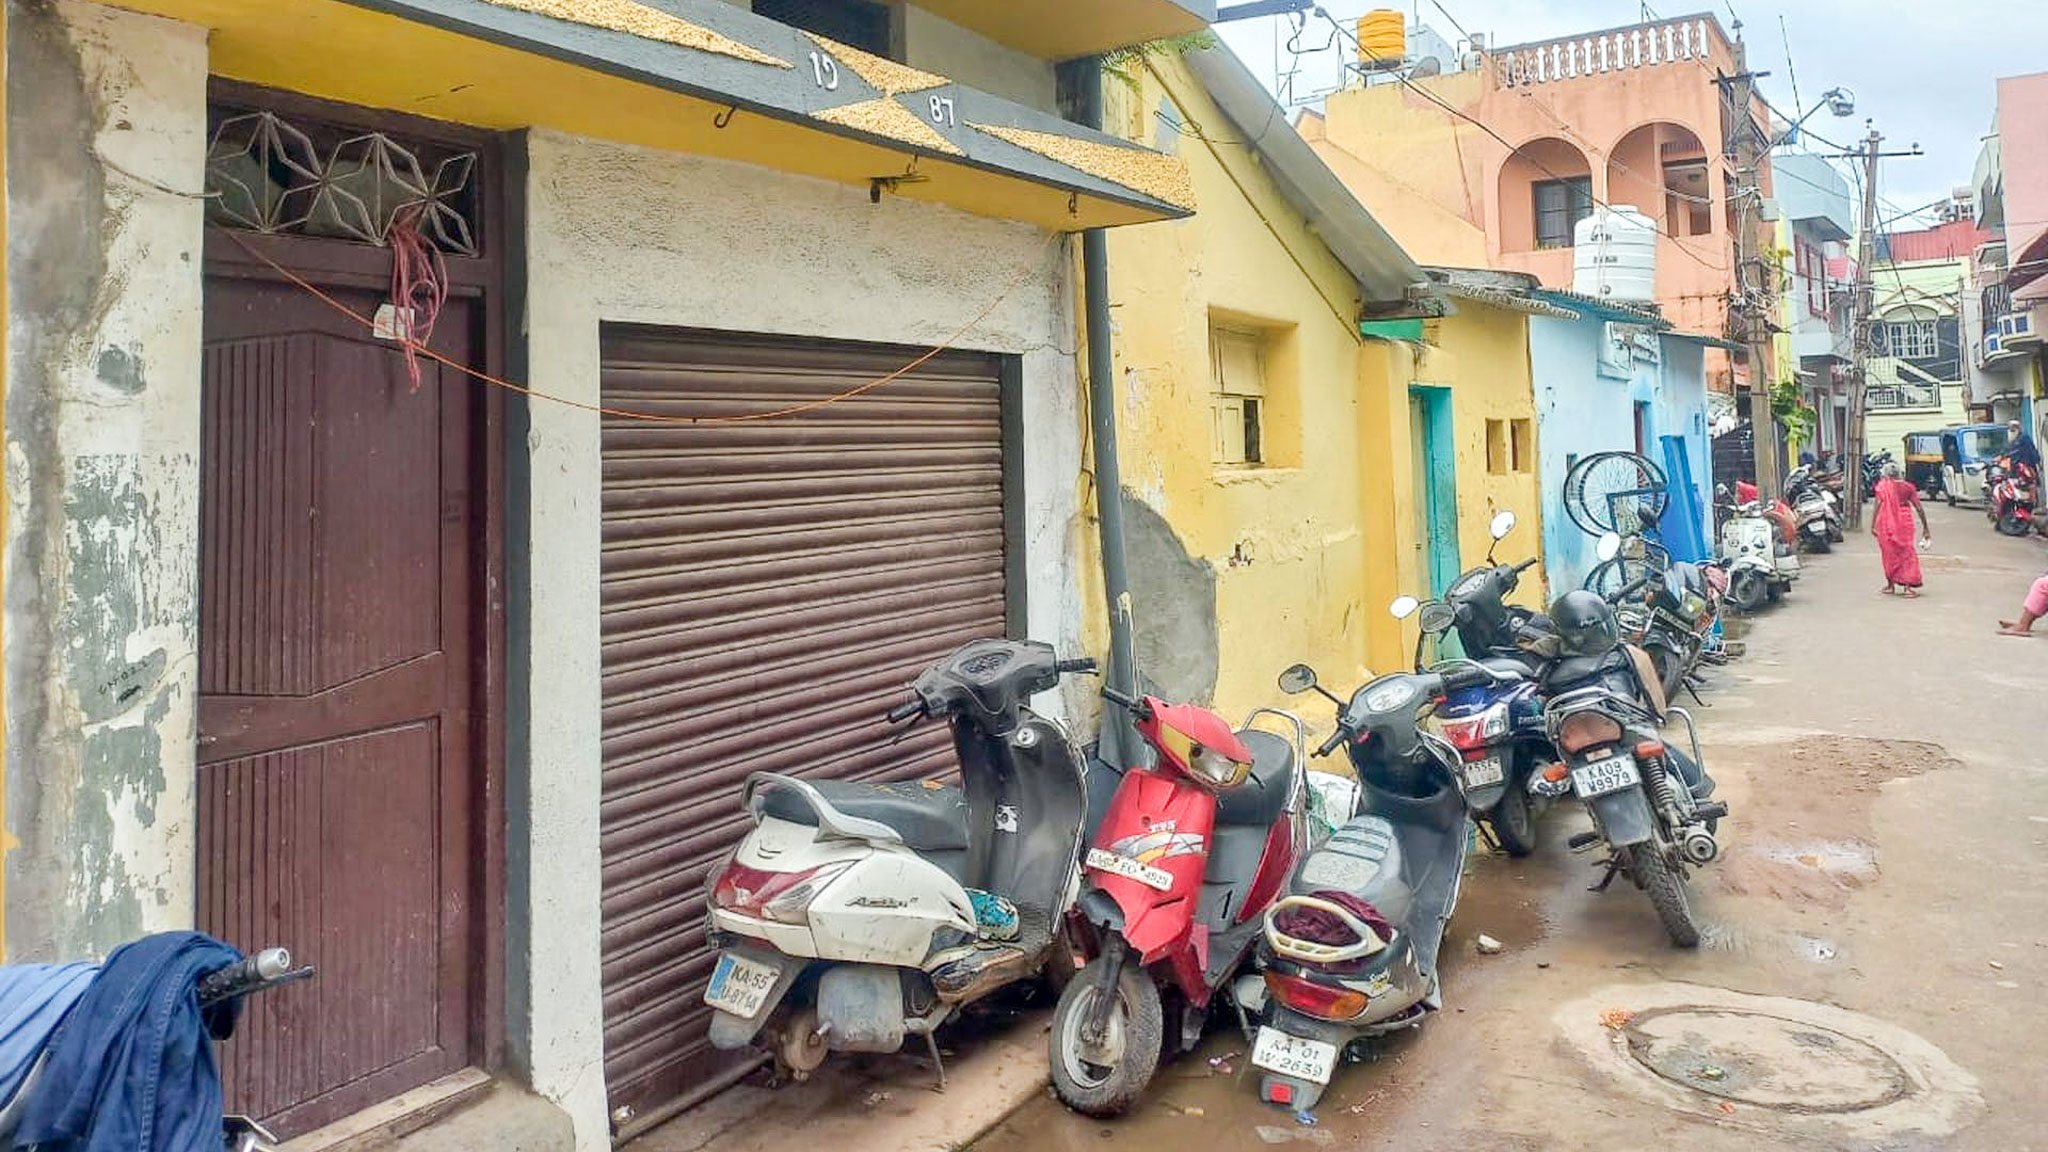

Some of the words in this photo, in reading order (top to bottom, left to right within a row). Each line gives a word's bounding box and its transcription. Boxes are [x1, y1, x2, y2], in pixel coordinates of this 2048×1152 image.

[809, 52, 838, 90] 19
[928, 95, 955, 127] 87
[1588, 761, 1622, 779] KA09
[1270, 1039, 1293, 1054] KA
[1301, 1047, 1320, 1060] 01
